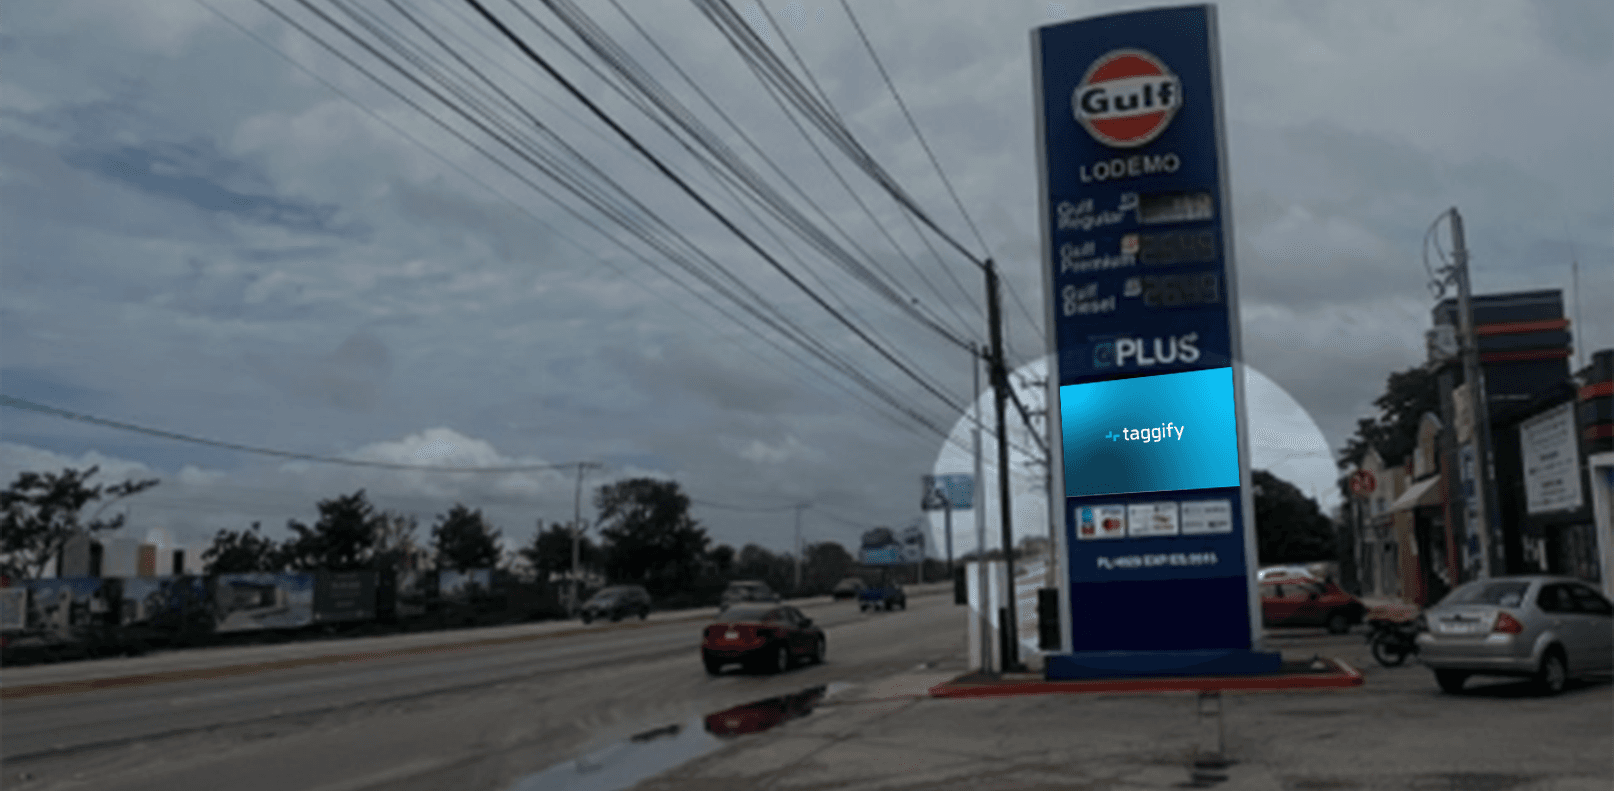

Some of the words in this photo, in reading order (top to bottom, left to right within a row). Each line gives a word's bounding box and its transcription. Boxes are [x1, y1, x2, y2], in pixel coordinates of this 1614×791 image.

[1082, 83, 1174, 112] Gulf
[1080, 154, 1180, 181] LODEMO
[1116, 333, 1199, 366] PLUS
[1122, 421, 1185, 444] taggify
